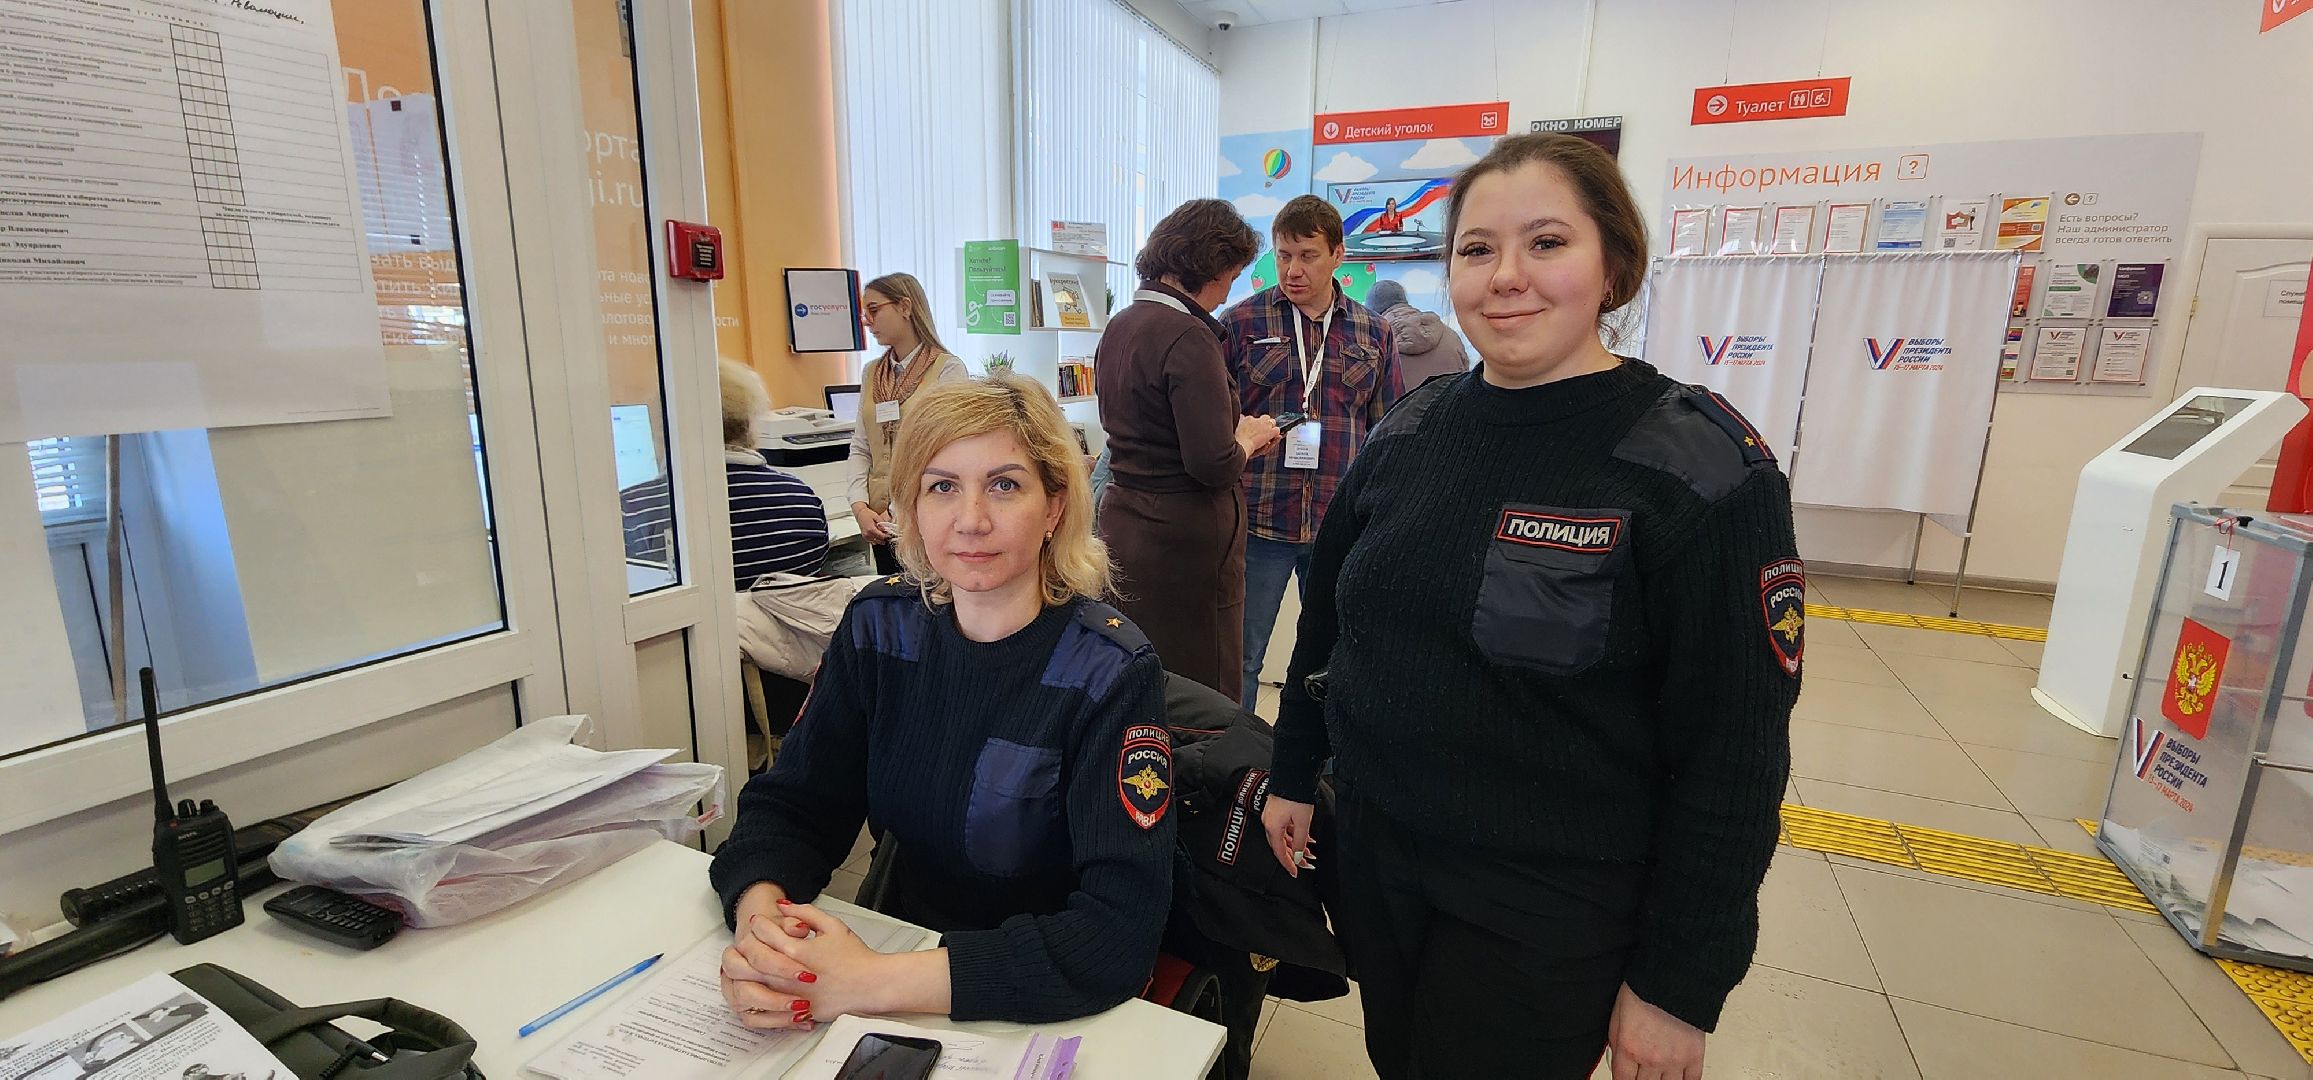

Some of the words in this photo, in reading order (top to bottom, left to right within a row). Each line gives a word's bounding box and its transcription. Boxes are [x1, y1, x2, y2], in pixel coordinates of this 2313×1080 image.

[1735, 100, 1786, 117] Туалет
[1345, 123, 1392, 140] Детский
[1395, 123, 1434, 137] уголок
[1531, 121, 1568, 132] ОКНО
[1574, 117, 1622, 129] НОМЕР
[1672, 161, 1882, 194] Информация
[2059, 214, 2082, 222] Есть
[2085, 213, 2139, 223] вопросы?
[2084, 225, 2169, 234] администратор
[1902, 347, 1952, 355] ПРЕЗИДЕНТА
[1508, 518, 1610, 547] ПОЛИЦИЯ
[2214, 560, 2230, 590] 1
[1128, 750, 1168, 768] РОССИЯ
[2166, 738, 2201, 765] ВЫБОРЫ
[2154, 764, 2183, 790] РОССИИ
[2159, 751, 2208, 788] ПРЕЗИДЕНТА
[2178, 798, 2194, 813] 2024
[1136, 812, 1156, 827] МВД
[1221, 805, 1245, 861] ПОЛИЦИ
